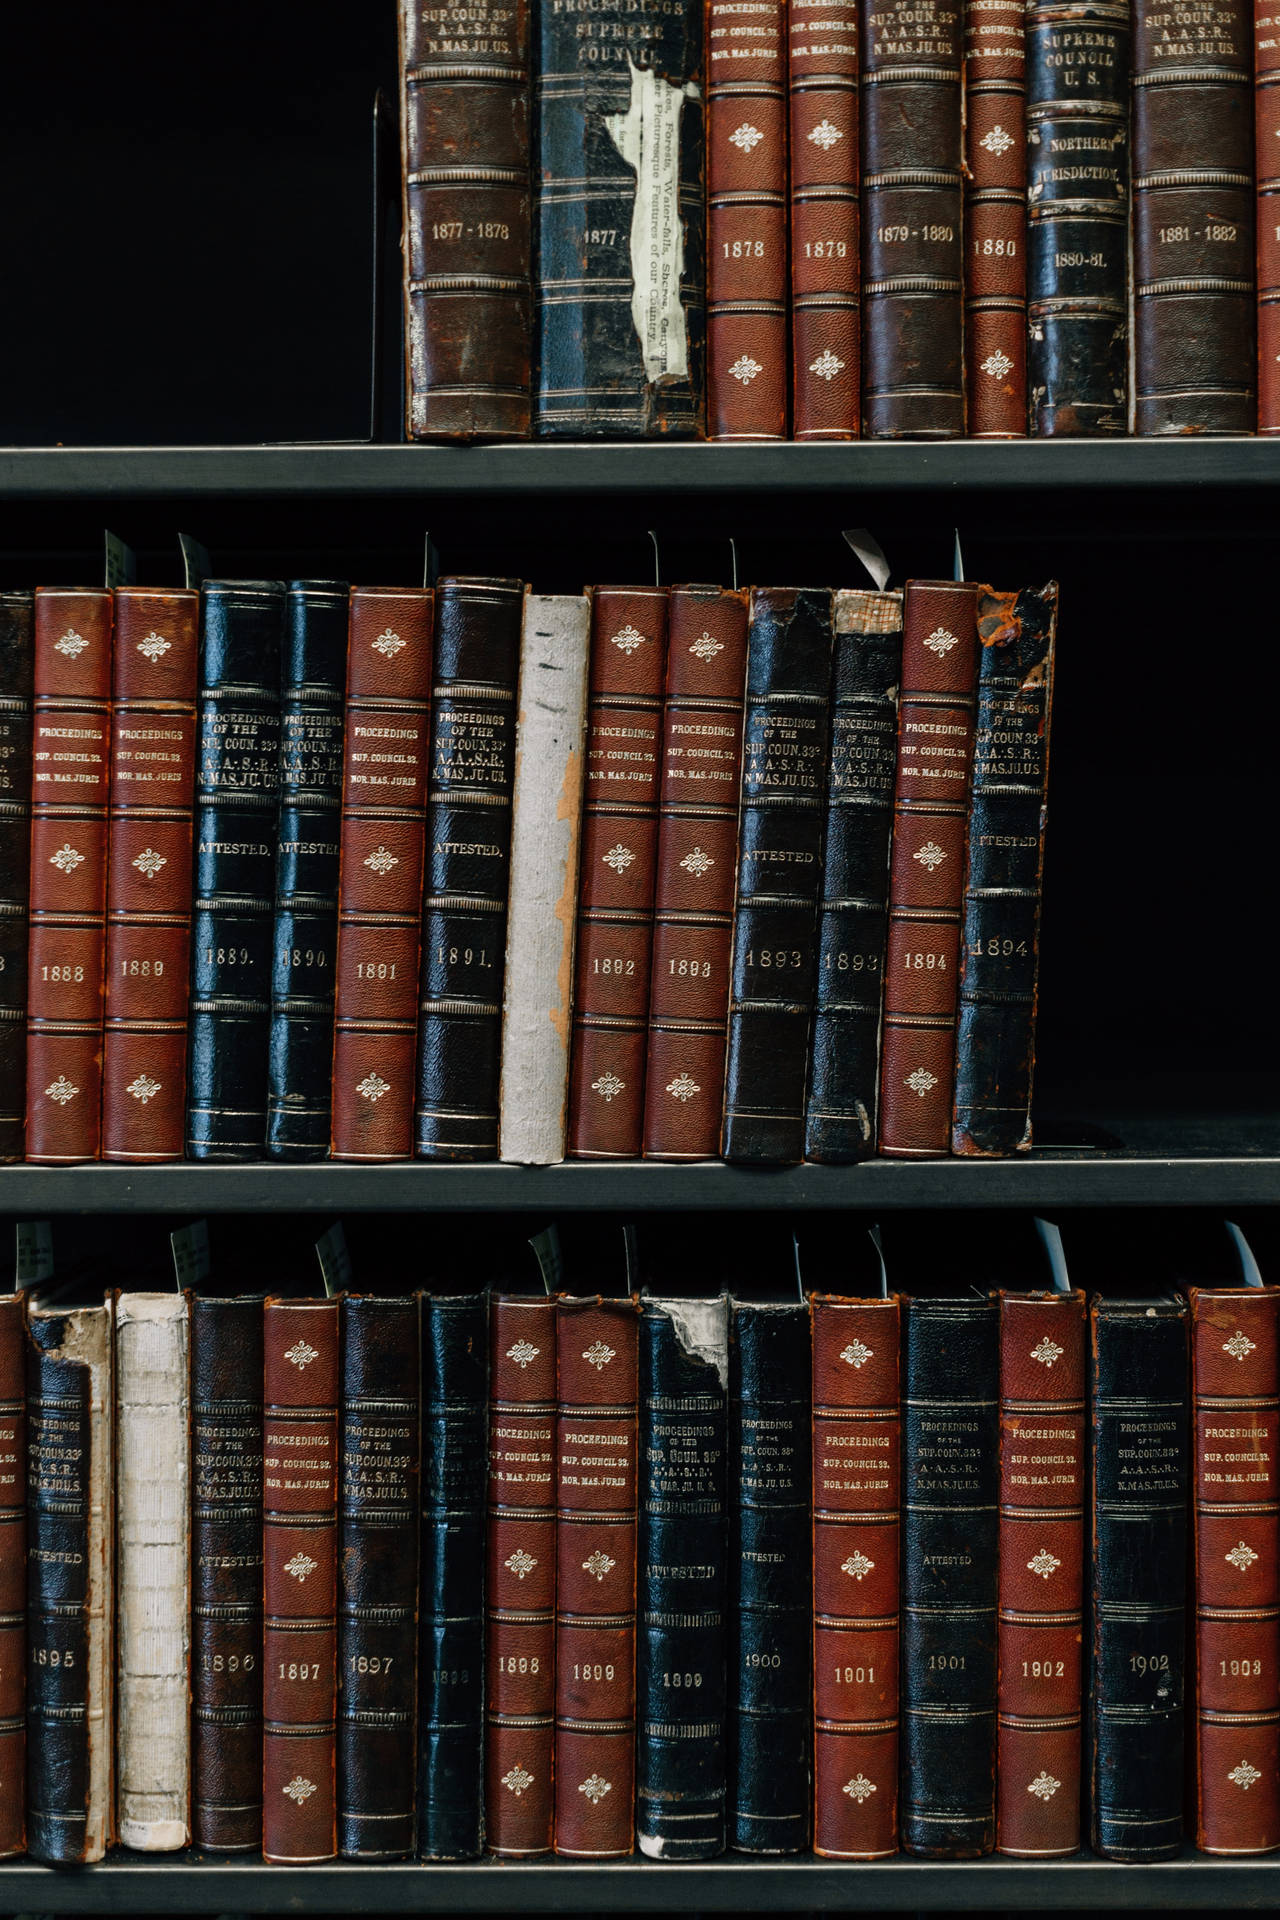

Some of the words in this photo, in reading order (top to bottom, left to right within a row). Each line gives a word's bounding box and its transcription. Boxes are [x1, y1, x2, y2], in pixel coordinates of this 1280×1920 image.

[713, 3, 778, 16] PROCEEDINGS
[1042, 32, 1116, 50] SUPREME
[1045, 53, 1115, 68] COUNCIL
[1064, 71, 1080, 86] U.
[1087, 70, 1101, 85] S.
[651, 103, 663, 179] Picturesque
[1051, 137, 1116, 153] NORTHERN
[431, 223, 464, 240] 1877
[476, 223, 510, 240] 1878
[878, 226, 910, 243] 1879
[921, 224, 954, 242] 1880
[1158, 226, 1190, 244] 1881
[1204, 225, 1238, 242] 1882
[650, 244, 660, 258] of
[723, 240, 764, 258] 1878
[974, 239, 1016, 257] 1880
[649, 260, 659, 284] our
[439, 711, 505, 726] PROCEEDINGS
[39, 727, 103, 741] PROCEEDINGS
[119, 729, 183, 741] PROCEEDINGS
[212, 724, 228, 735] OF
[232, 724, 259, 735] THE
[308, 727, 333, 738] THE
[354, 726, 418, 740] PROCEEDINGS
[450, 725, 466, 736] OF
[470, 726, 494, 738] THE
[592, 725, 656, 740] PROCEEDINGS
[671, 724, 736, 737] PROCEEDINGS
[763, 729, 774, 739] OF
[780, 729, 798, 739] THE
[905, 722, 968, 736] PROCEEDINGS
[35, 752, 52, 761] SUP.
[53, 752, 90, 763] COUNCIL
[116, 751, 134, 761] SUP.
[134, 751, 170, 762] COUNCIL
[351, 752, 370, 762] SUP.
[371, 753, 406, 764] COUNCIL
[607, 750, 643, 761] COUNCIL
[667, 747, 686, 757] SUP.
[687, 748, 722, 760] COUNCIL
[900, 746, 919, 755] SUP.
[920, 746, 957, 757] COUNCIL
[36, 773, 54, 782] NOR.
[117, 771, 135, 781] NOR.
[350, 773, 369, 784] NOR.
[666, 768, 687, 779] NOR.
[901, 766, 921, 777] NOR.
[433, 841, 504, 858] ATTESTED.
[742, 849, 815, 864] ATTESTED
[972, 938, 1029, 957] 1894
[435, 946, 493, 969] 1891.
[745, 950, 802, 969] 1893
[823, 953, 879, 972] 1893
[903, 953, 948, 971] 1894
[41, 965, 84, 982] 1888
[592, 957, 635, 977] 1892
[668, 959, 712, 978] 1893
[344, 1425, 411, 1439] PROCEEDINGS
[565, 1432, 629, 1446] PROCEEDINGS
[1012, 1428, 1076, 1440] PROCEEDINGS
[1204, 1427, 1269, 1439] PROCEEDINGS
[267, 1434, 329, 1447] PROCEEDINGS
[360, 1441, 371, 1450] OF
[374, 1441, 392, 1451] THE
[825, 1435, 890, 1448] PROCEEDINGS
[504, 1451, 540, 1463] COUNCIL
[561, 1455, 580, 1465] SUP.
[581, 1456, 617, 1467] COUNCIL
[823, 1458, 843, 1468] SUP.
[843, 1458, 878, 1470] COUNCIL
[1010, 1454, 1029, 1464] SUP.
[1030, 1455, 1065, 1465] COUNCIL
[1204, 1452, 1224, 1462] SUP.
[1224, 1453, 1260, 1463] COUNCIL
[283, 1459, 319, 1470] COUNCIL
[561, 1475, 581, 1486] NOR.
[823, 1478, 844, 1489] NOR.
[864, 1479, 889, 1489] JURIS
[1010, 1474, 1030, 1485] NOR.
[1031, 1475, 1050, 1485] MAS.
[1204, 1472, 1224, 1483] NOR.
[1225, 1473, 1245, 1483] MAS.
[923, 1554, 973, 1566] ATTESTED
[32, 1648, 75, 1669] 1895
[200, 1654, 255, 1673] 1896
[349, 1655, 393, 1676] 1897
[745, 1653, 781, 1669] 1900
[928, 1655, 967, 1671] 1901
[1021, 1660, 1065, 1678] 1902
[1129, 1654, 1169, 1679] 1902
